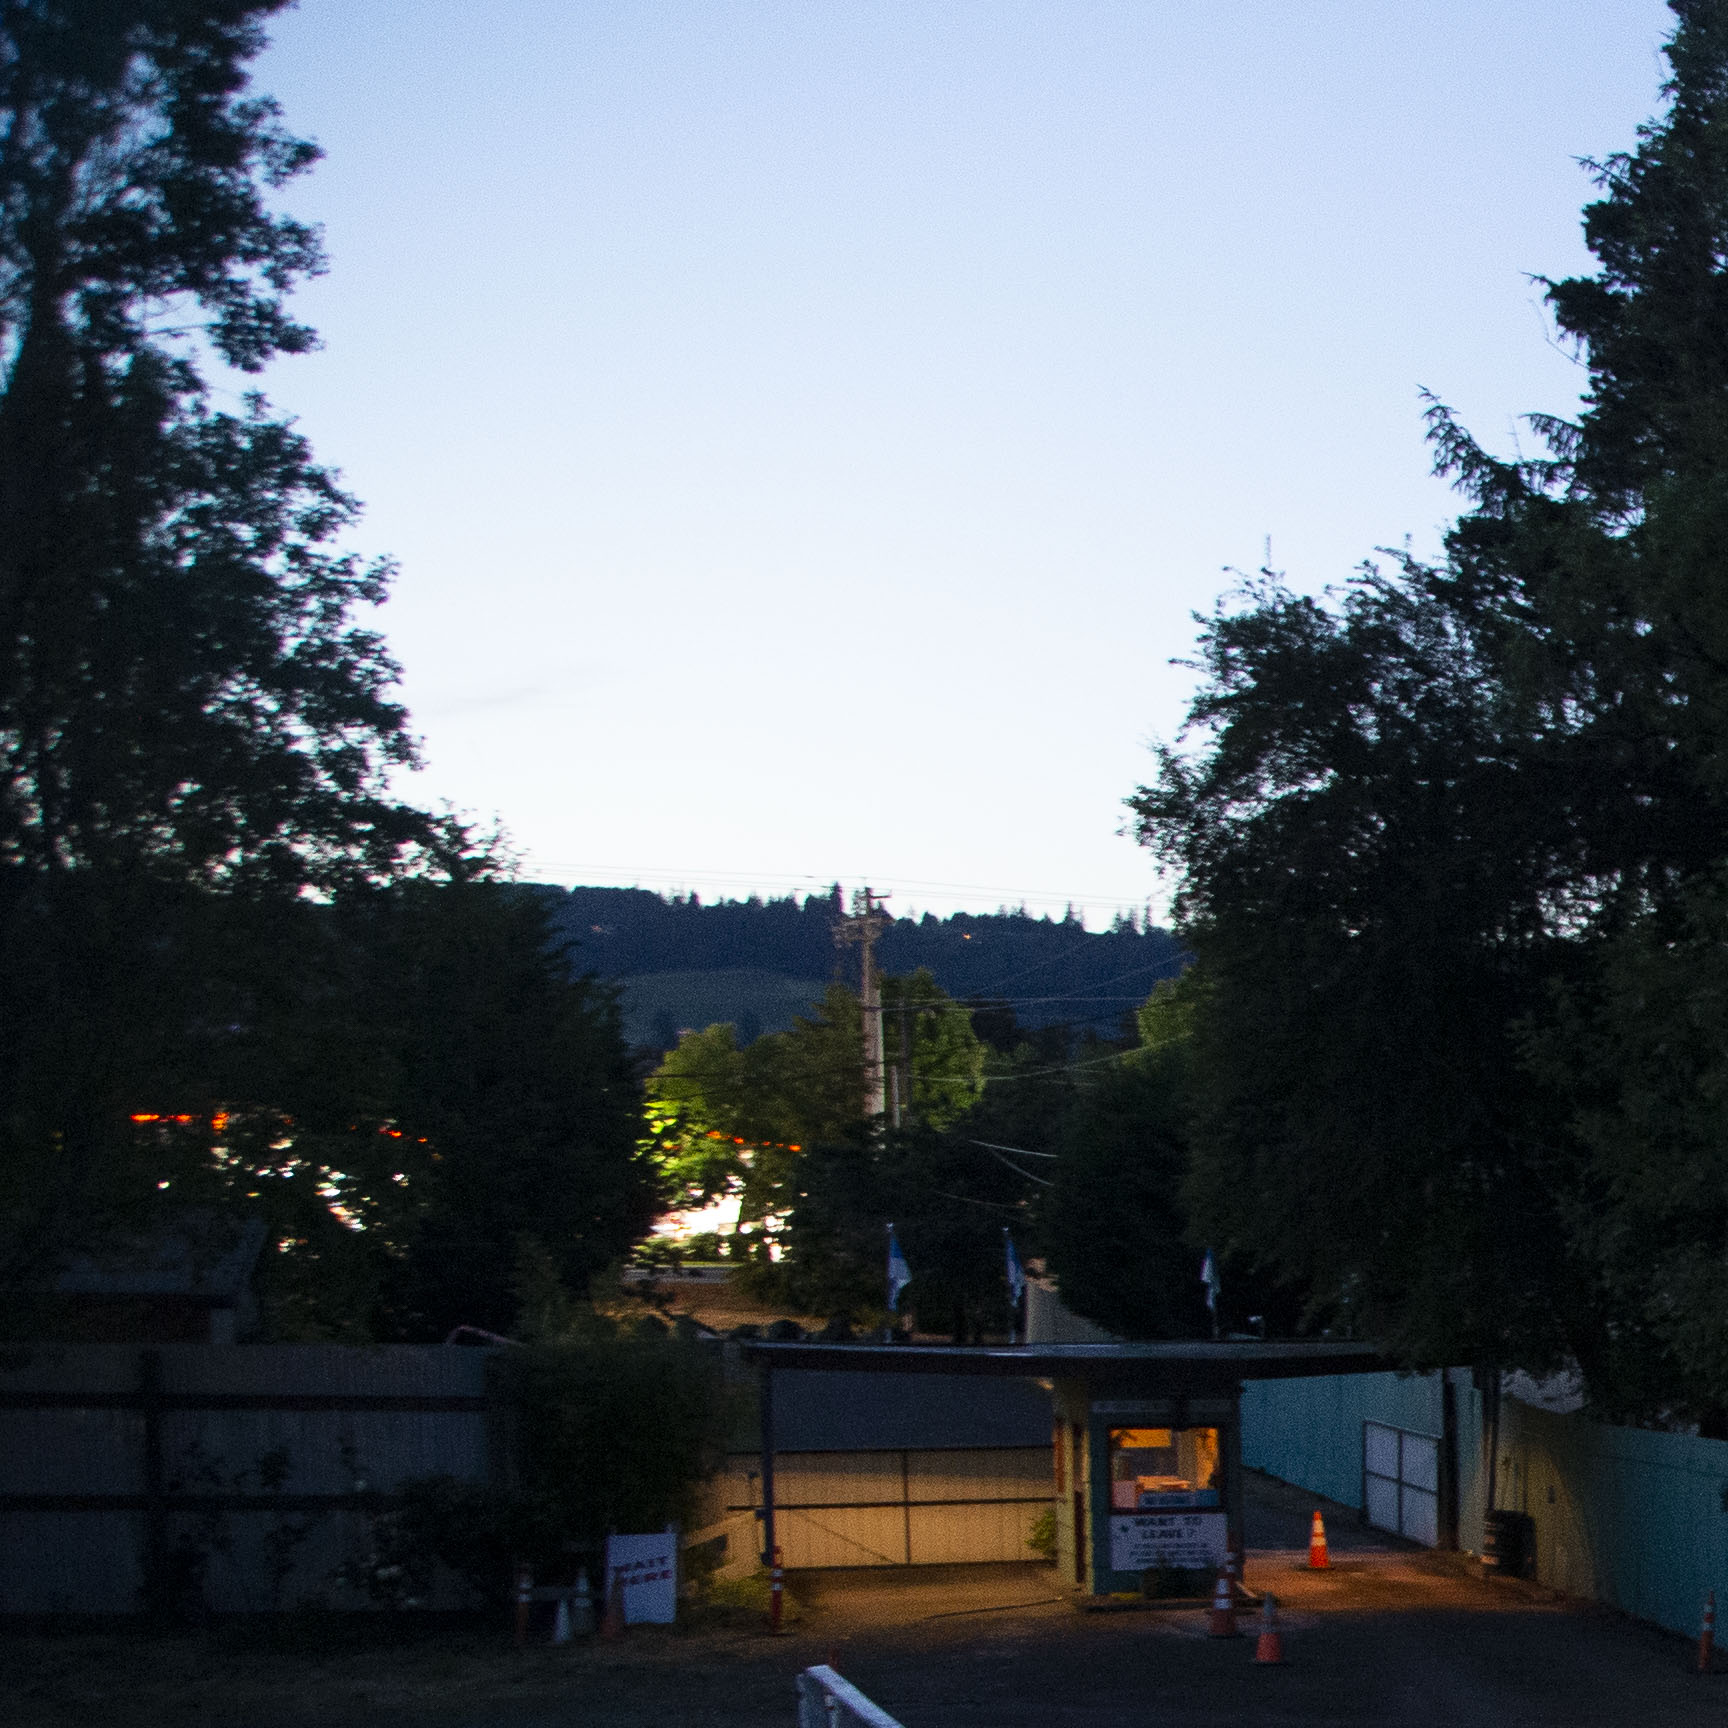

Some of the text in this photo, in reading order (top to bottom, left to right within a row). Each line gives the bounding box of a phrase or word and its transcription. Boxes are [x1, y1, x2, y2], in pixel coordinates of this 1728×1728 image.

[1134, 1516, 1203, 1527] WANT TO
[613, 1556, 667, 1572] WAIT
